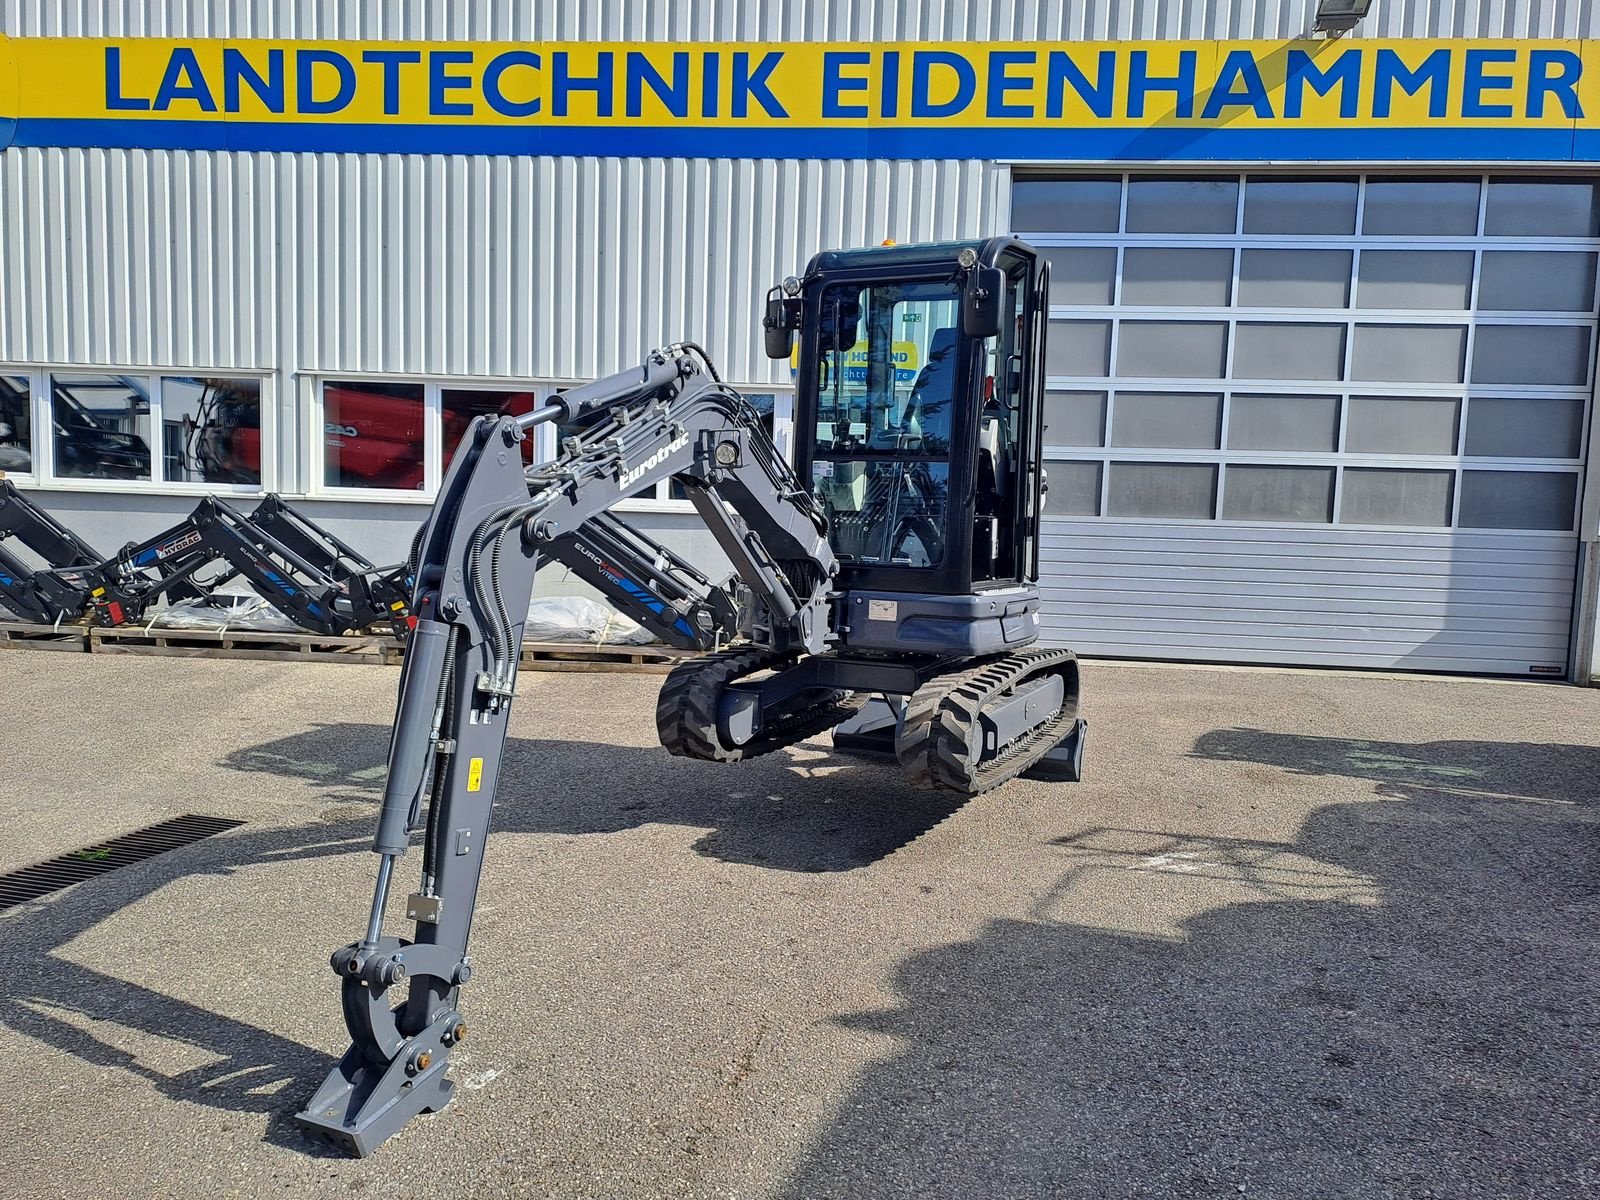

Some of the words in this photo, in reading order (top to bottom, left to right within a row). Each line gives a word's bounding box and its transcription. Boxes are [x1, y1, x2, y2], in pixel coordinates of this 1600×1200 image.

[105, 47, 789, 118] LANDTECHNIK
[822, 49, 1584, 119] EIDENHAMMER
[619, 432, 689, 491] Eurotrac
[164, 535, 200, 555] HYDRAC
